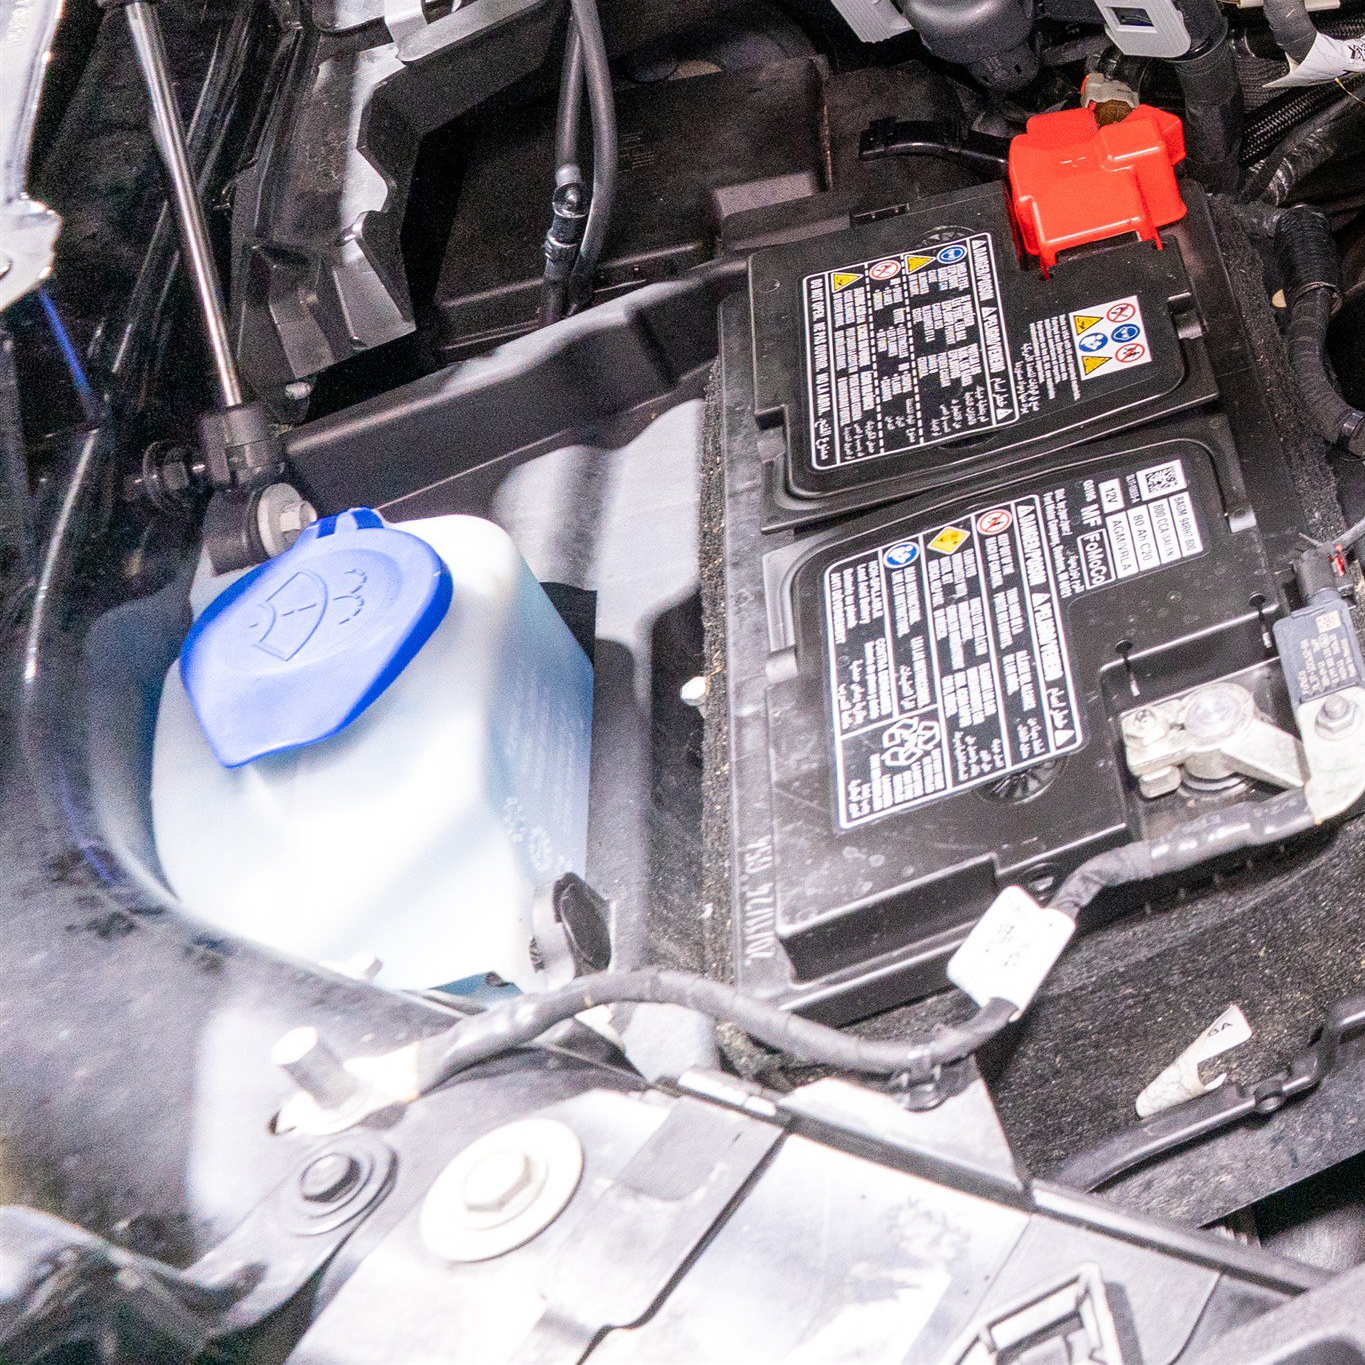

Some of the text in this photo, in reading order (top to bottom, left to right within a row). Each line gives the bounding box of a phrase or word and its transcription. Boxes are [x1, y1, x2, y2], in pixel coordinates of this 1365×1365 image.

[810, 278, 821, 288] DO
[810, 287, 822, 302] NOT
[811, 301, 823, 321] OPEN.
[972, 246, 1005, 373] DANGER/POISON PELIGRO/VENENO
[813, 322, 824, 332] NE
[813, 330, 825, 345] PAS
[816, 372, 827, 384] NO
[817, 383, 828, 394] LA
[817, 393, 830, 415] ABRA.
[1104, 486, 1118, 504] 12V
[1079, 503, 1102, 529] MF
[1153, 503, 1169, 533] 800 CCA
[1133, 513, 1152, 561] 80 Ah C20
[1082, 532, 1108, 585] FoMoCo
[1018, 512, 1062, 682] DANGER/POISON PELIGRO/VENENO
